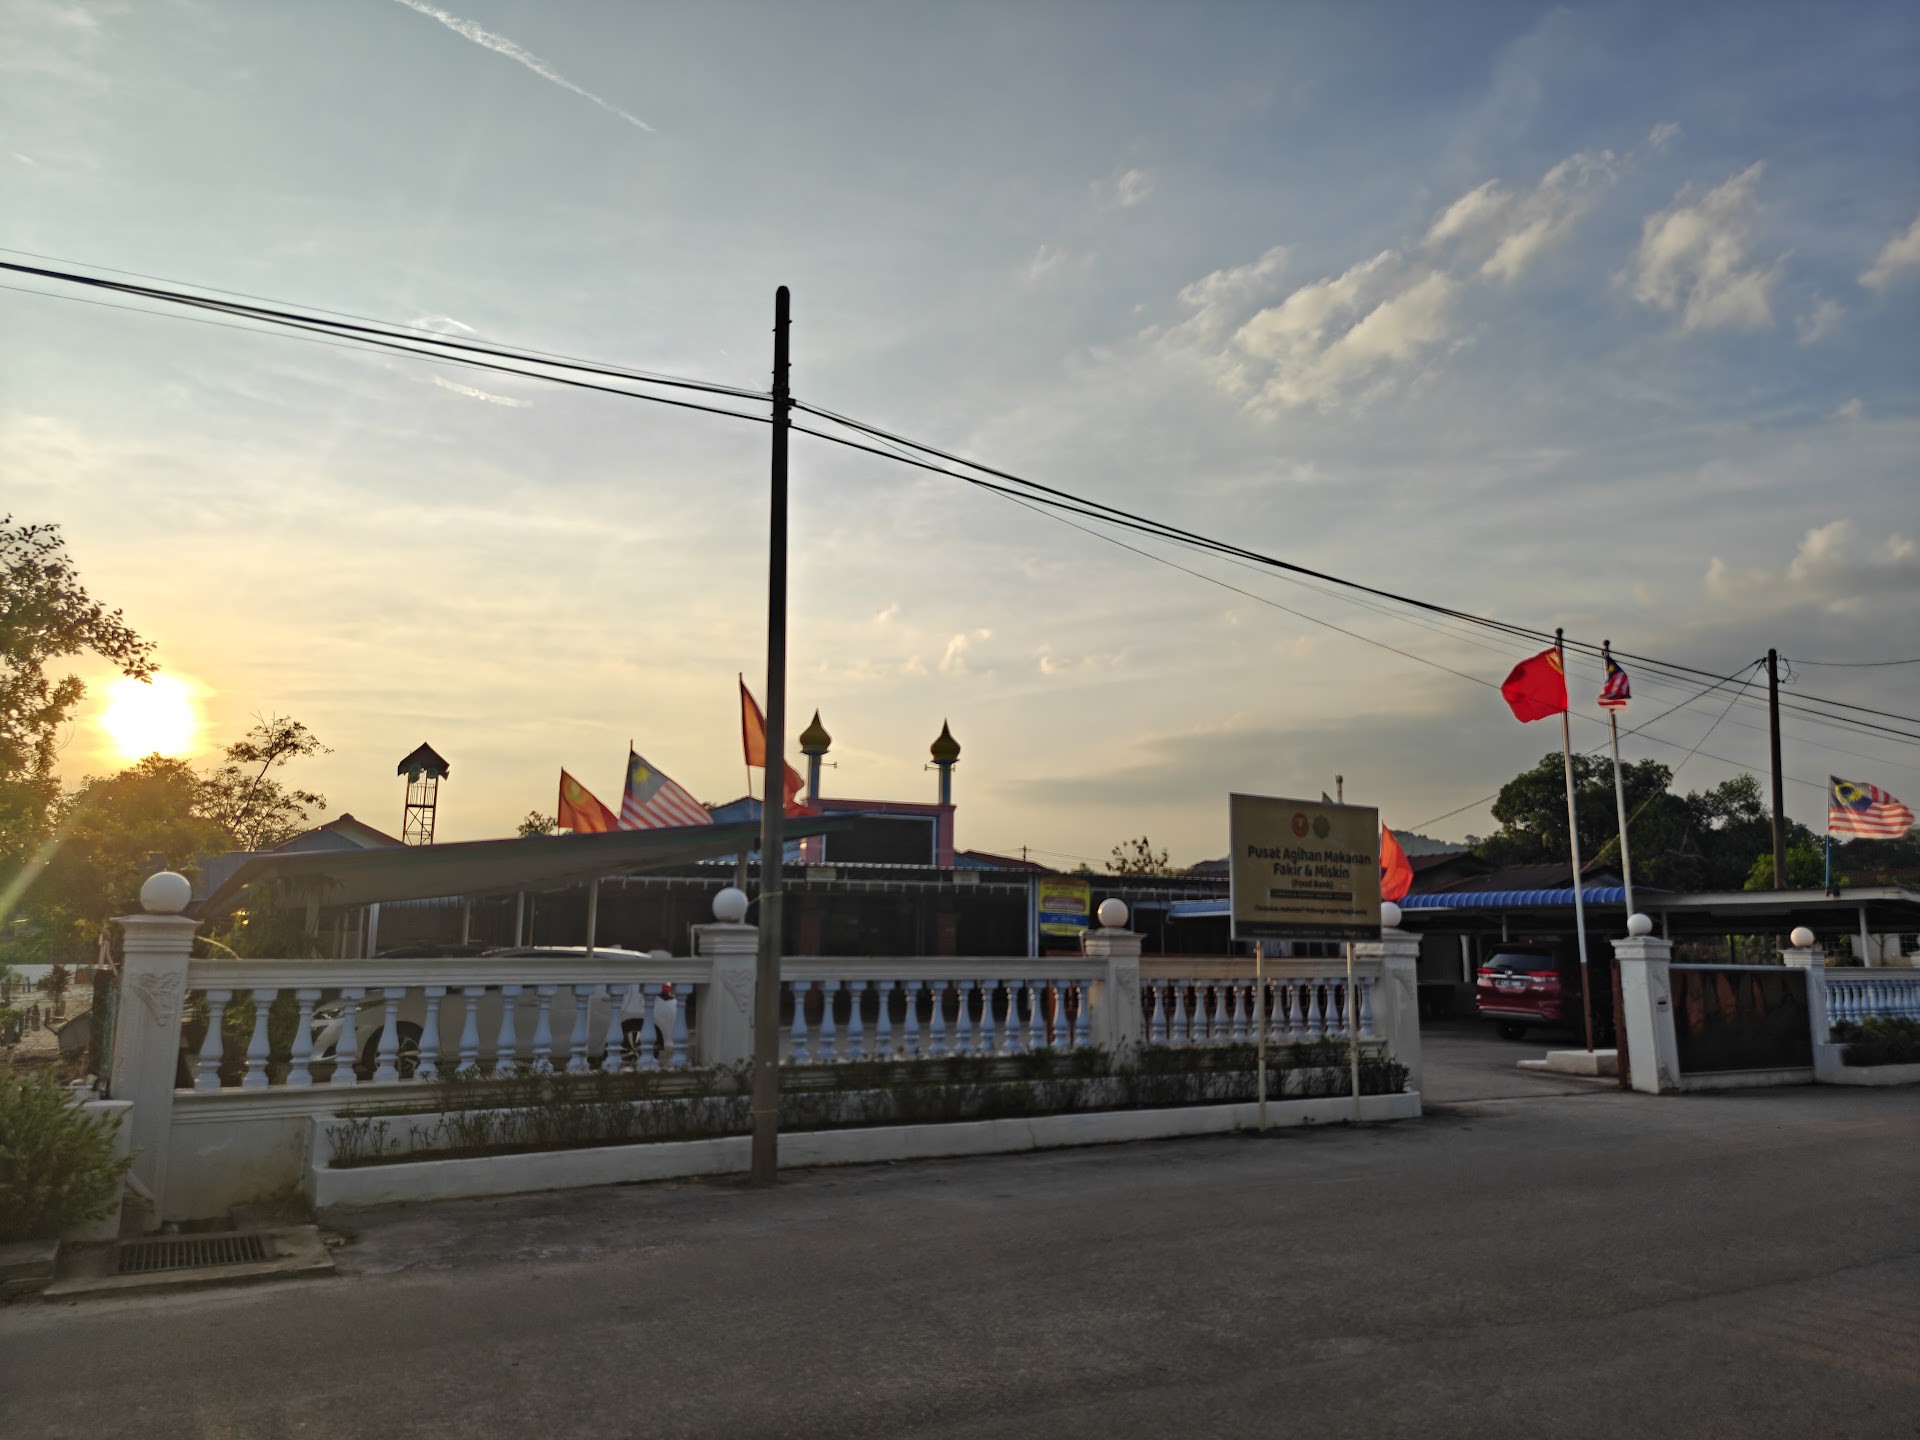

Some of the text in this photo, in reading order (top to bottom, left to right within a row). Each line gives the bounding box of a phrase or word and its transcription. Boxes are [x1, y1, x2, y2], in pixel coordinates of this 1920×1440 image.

[1248, 845, 1371, 864] Pusat Agihan Makanan
[1274, 863, 1349, 878] Fakir & Miskin
